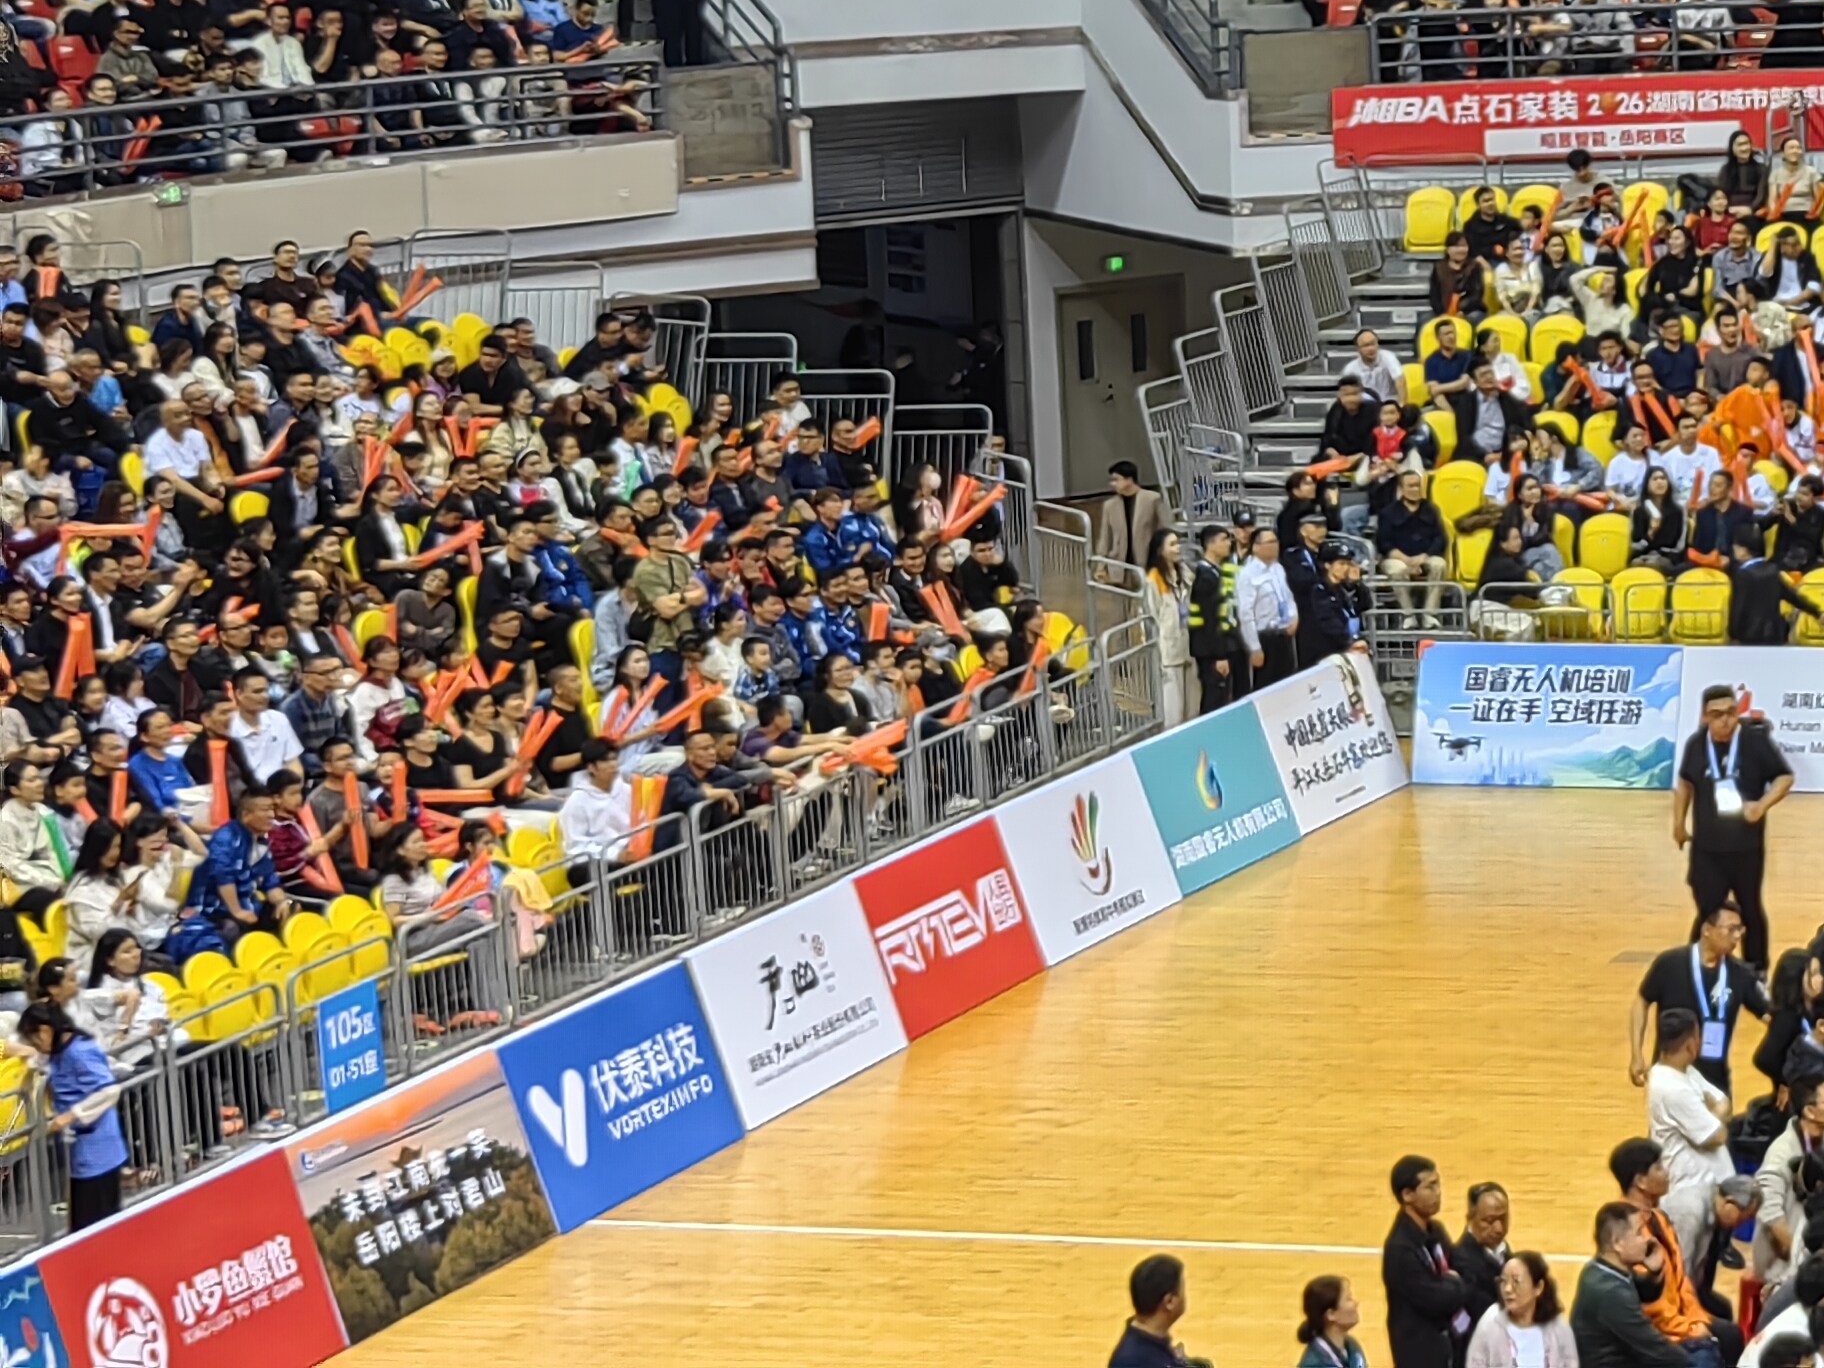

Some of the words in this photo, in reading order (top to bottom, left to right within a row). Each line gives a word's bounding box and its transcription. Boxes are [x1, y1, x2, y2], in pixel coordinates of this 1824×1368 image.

[1453, 91, 1580, 125] 点石家装
[1463, 665, 1633, 694] 国睿无人机培训
[326, 1004, 377, 1050] 105区
[589, 1022, 706, 1115] 伏泰科技
[171, 1234, 299, 1329] 小罗鱼蟹馆
